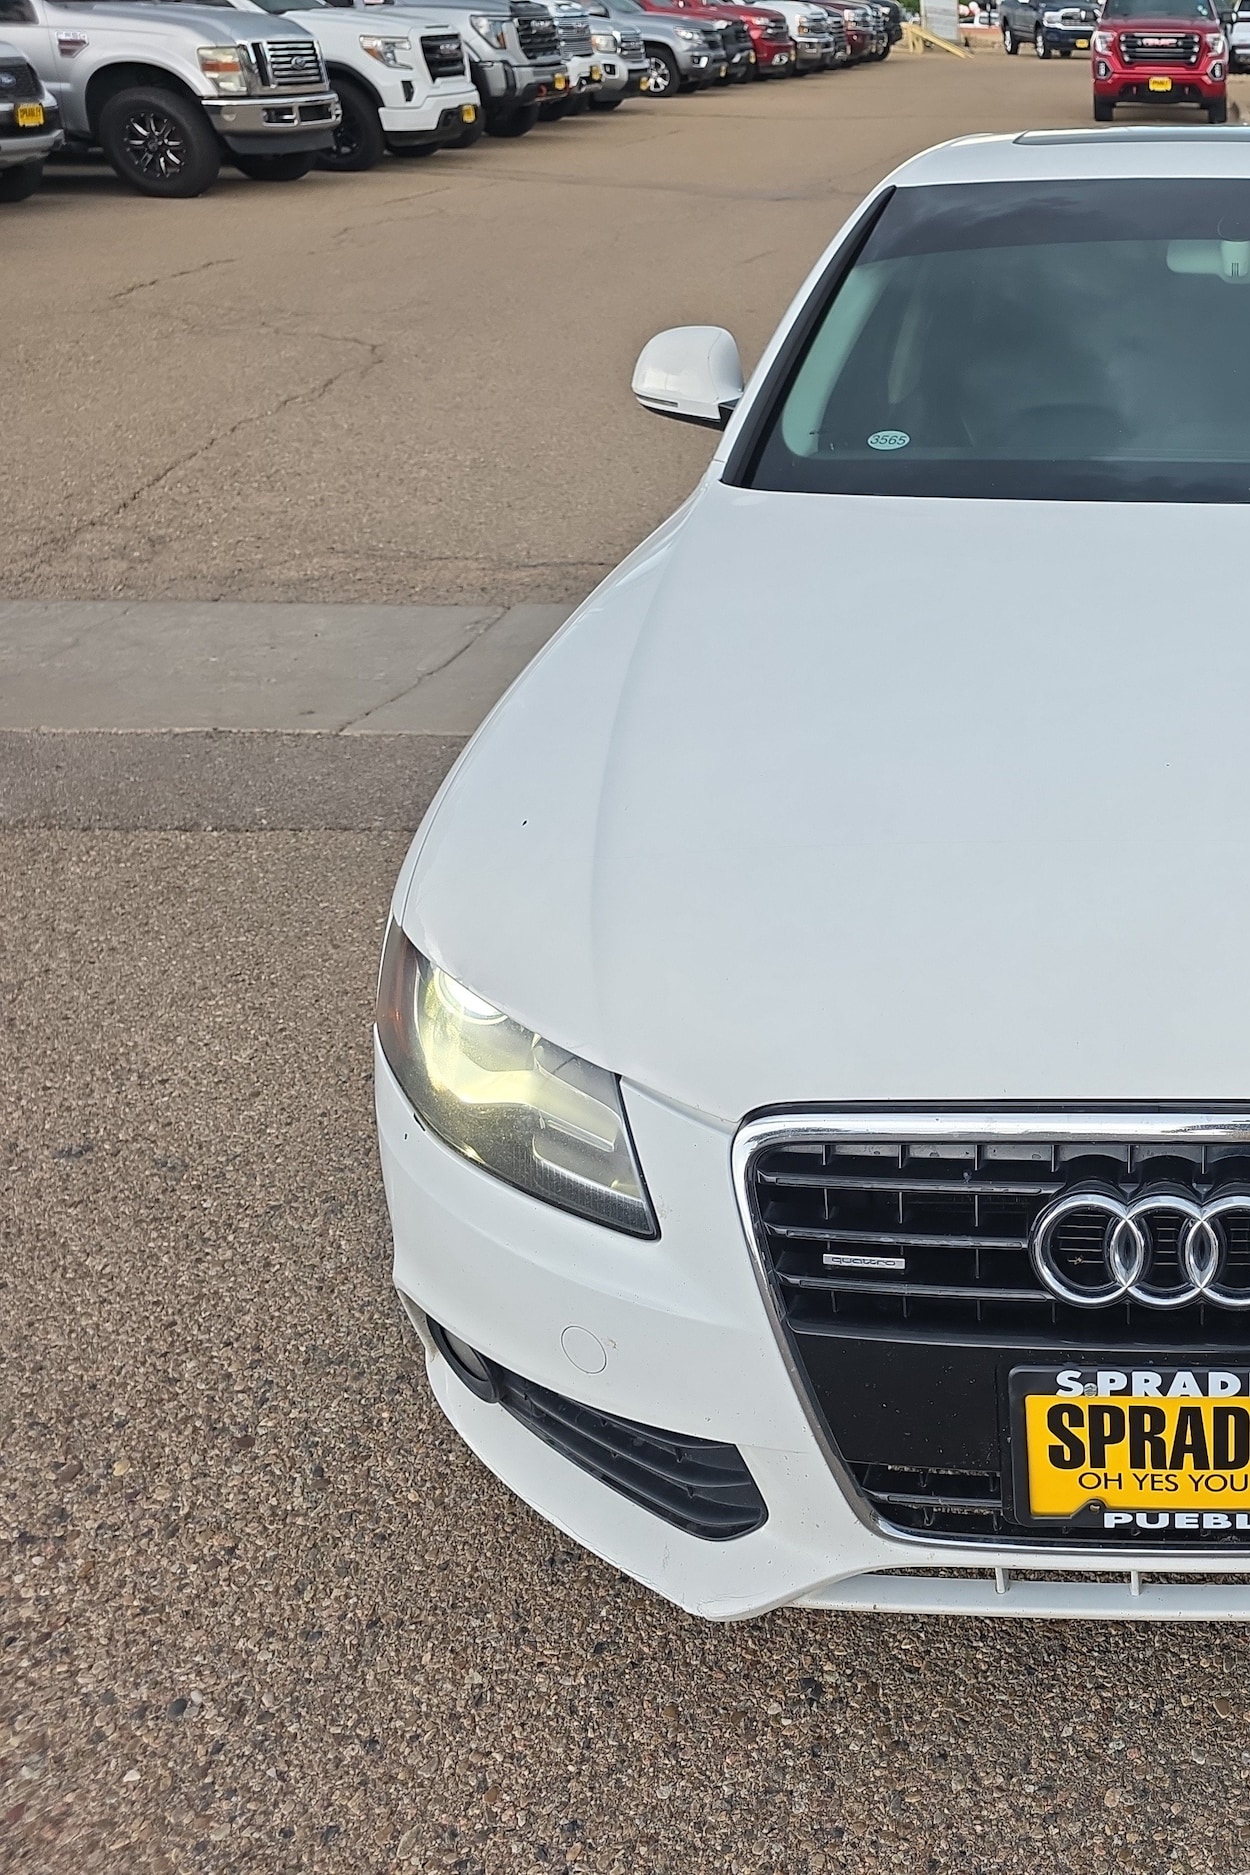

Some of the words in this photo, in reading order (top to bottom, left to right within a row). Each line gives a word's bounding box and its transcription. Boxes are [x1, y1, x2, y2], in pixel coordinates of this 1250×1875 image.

[870, 434, 907, 446] 3565
[832, 1257, 896, 1267] quattro
[1078, 1472, 1123, 1491] OH
[1132, 1472, 1180, 1492] YES
[1191, 1473, 1249, 1493] YOU
